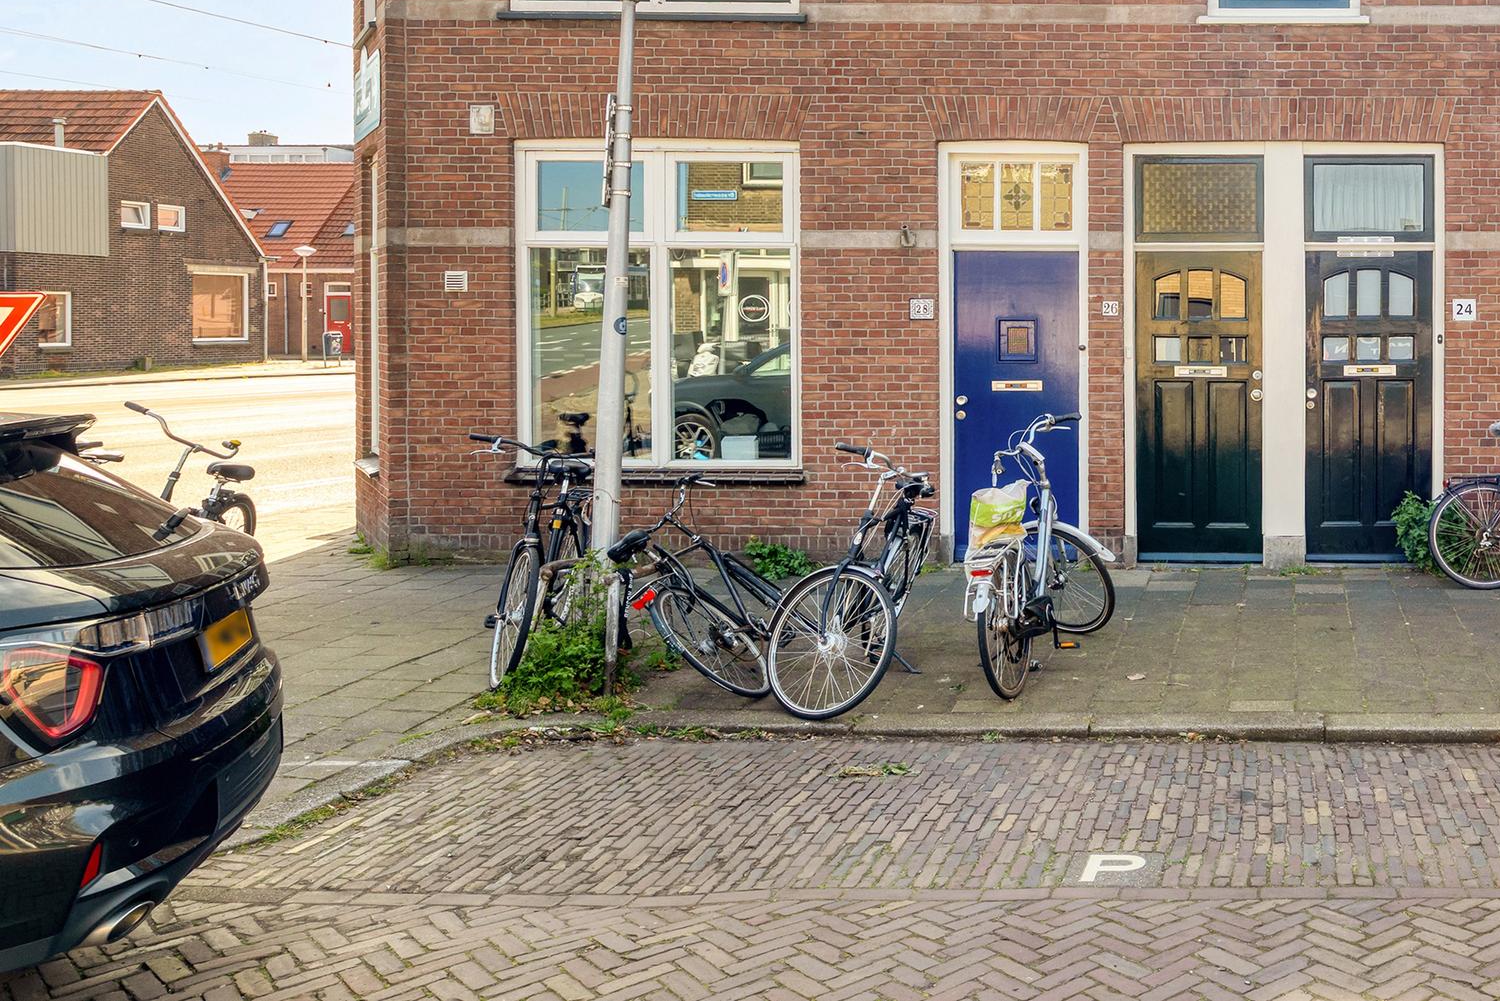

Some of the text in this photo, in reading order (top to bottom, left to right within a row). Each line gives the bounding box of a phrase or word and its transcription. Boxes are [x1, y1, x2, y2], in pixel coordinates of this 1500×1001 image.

[916, 304, 928, 314] 28
[1103, 302, 1118, 315] 26
[1456, 303, 1473, 315] 24
[1079, 854, 1146, 882] P
